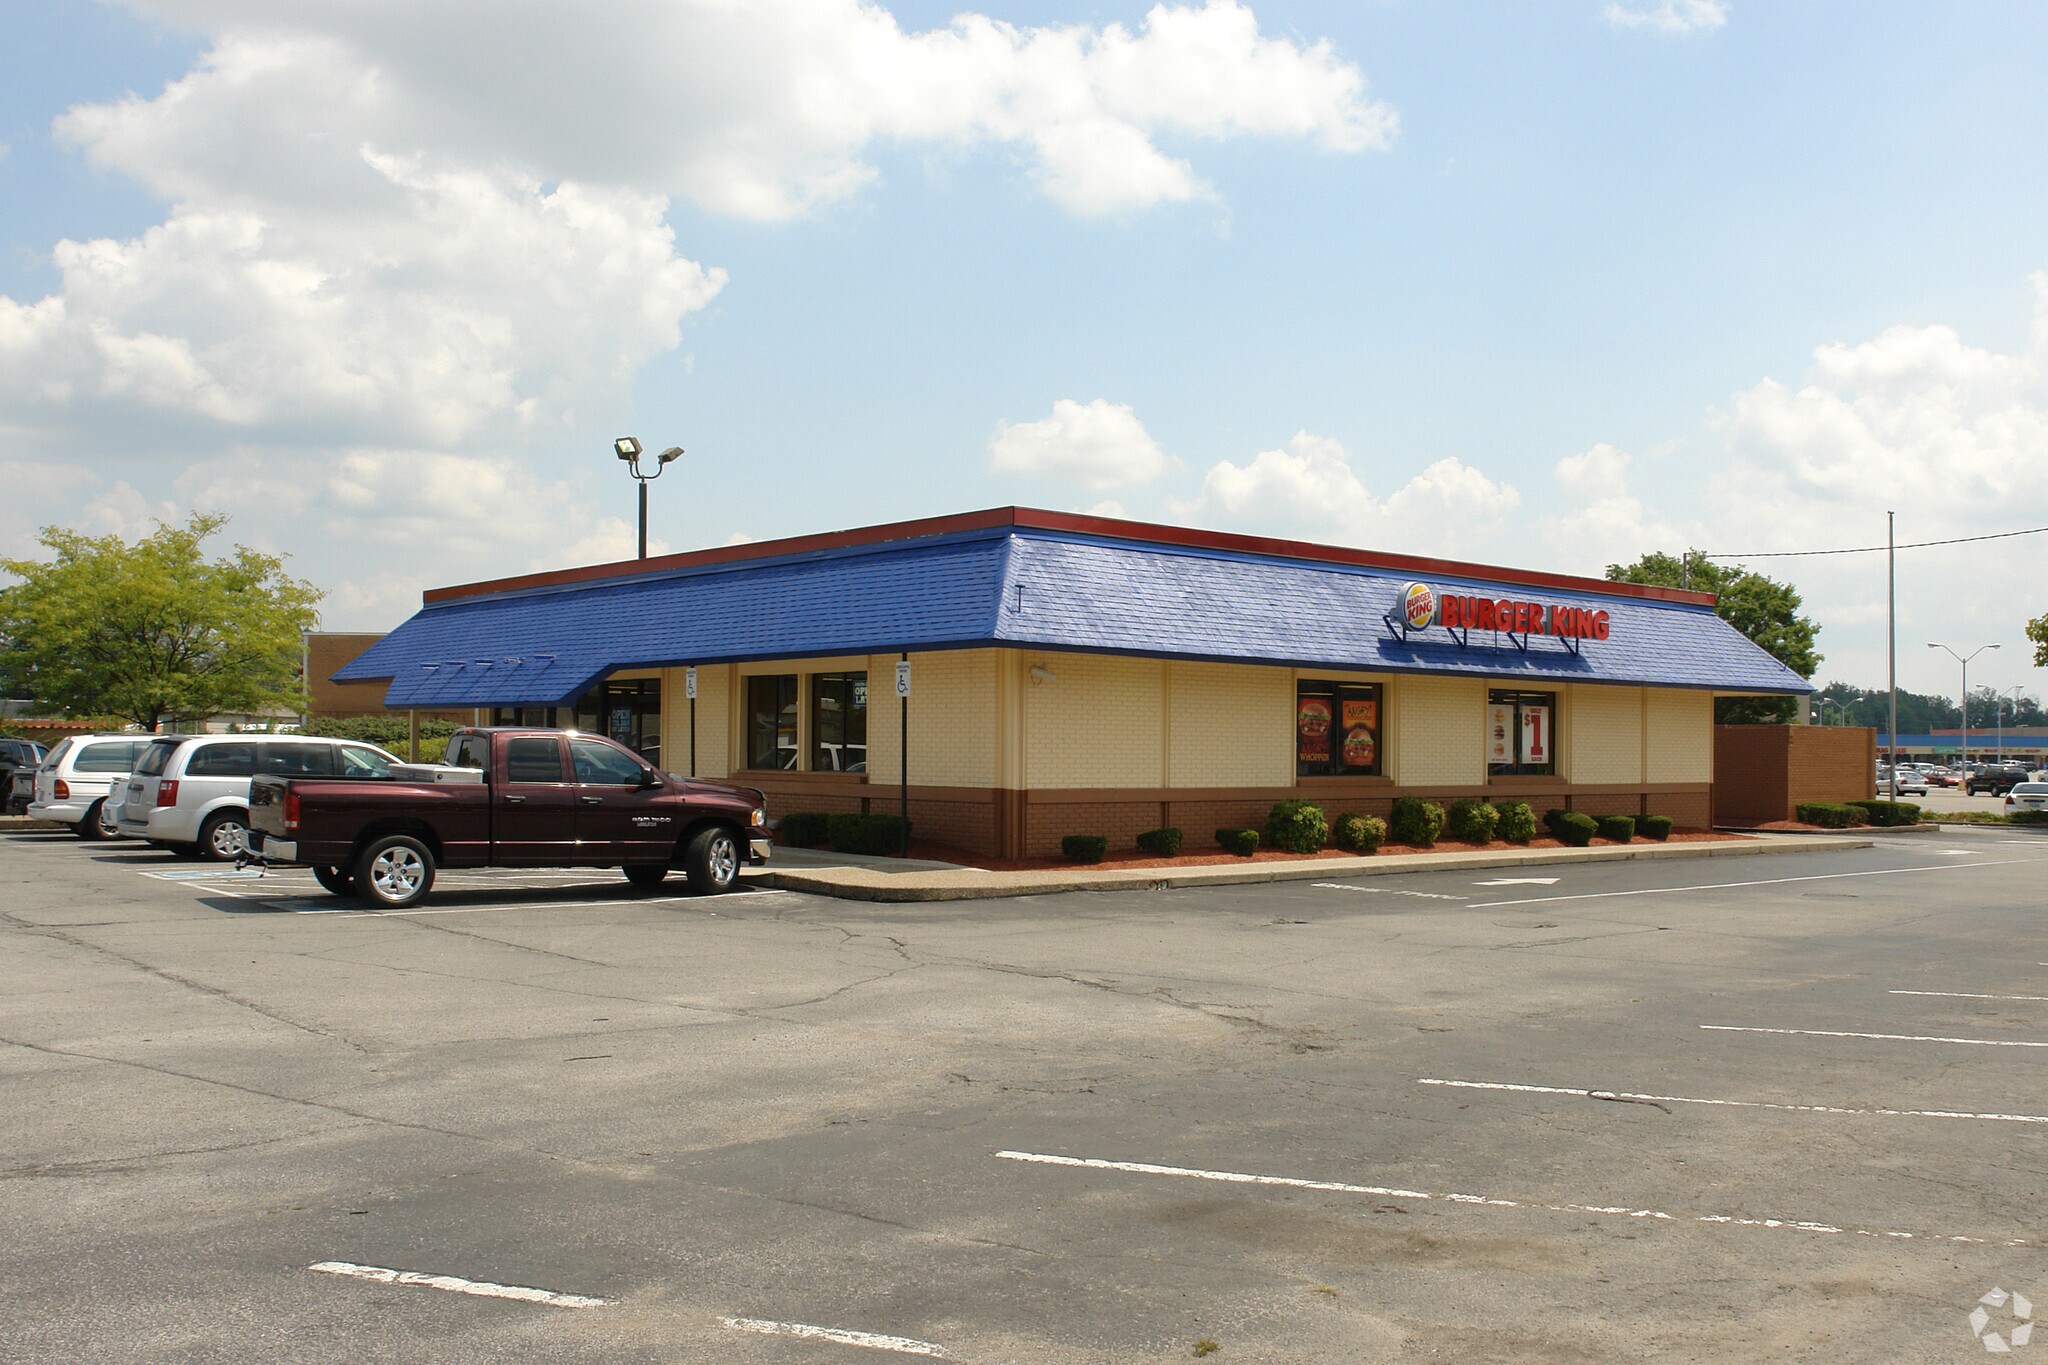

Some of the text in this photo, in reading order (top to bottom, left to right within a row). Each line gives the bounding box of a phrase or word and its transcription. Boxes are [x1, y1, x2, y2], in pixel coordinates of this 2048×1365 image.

[1407, 591, 1432, 609] BURGER
[1407, 600, 1432, 622] KING
[1441, 594, 1610, 641] BURGER KING
